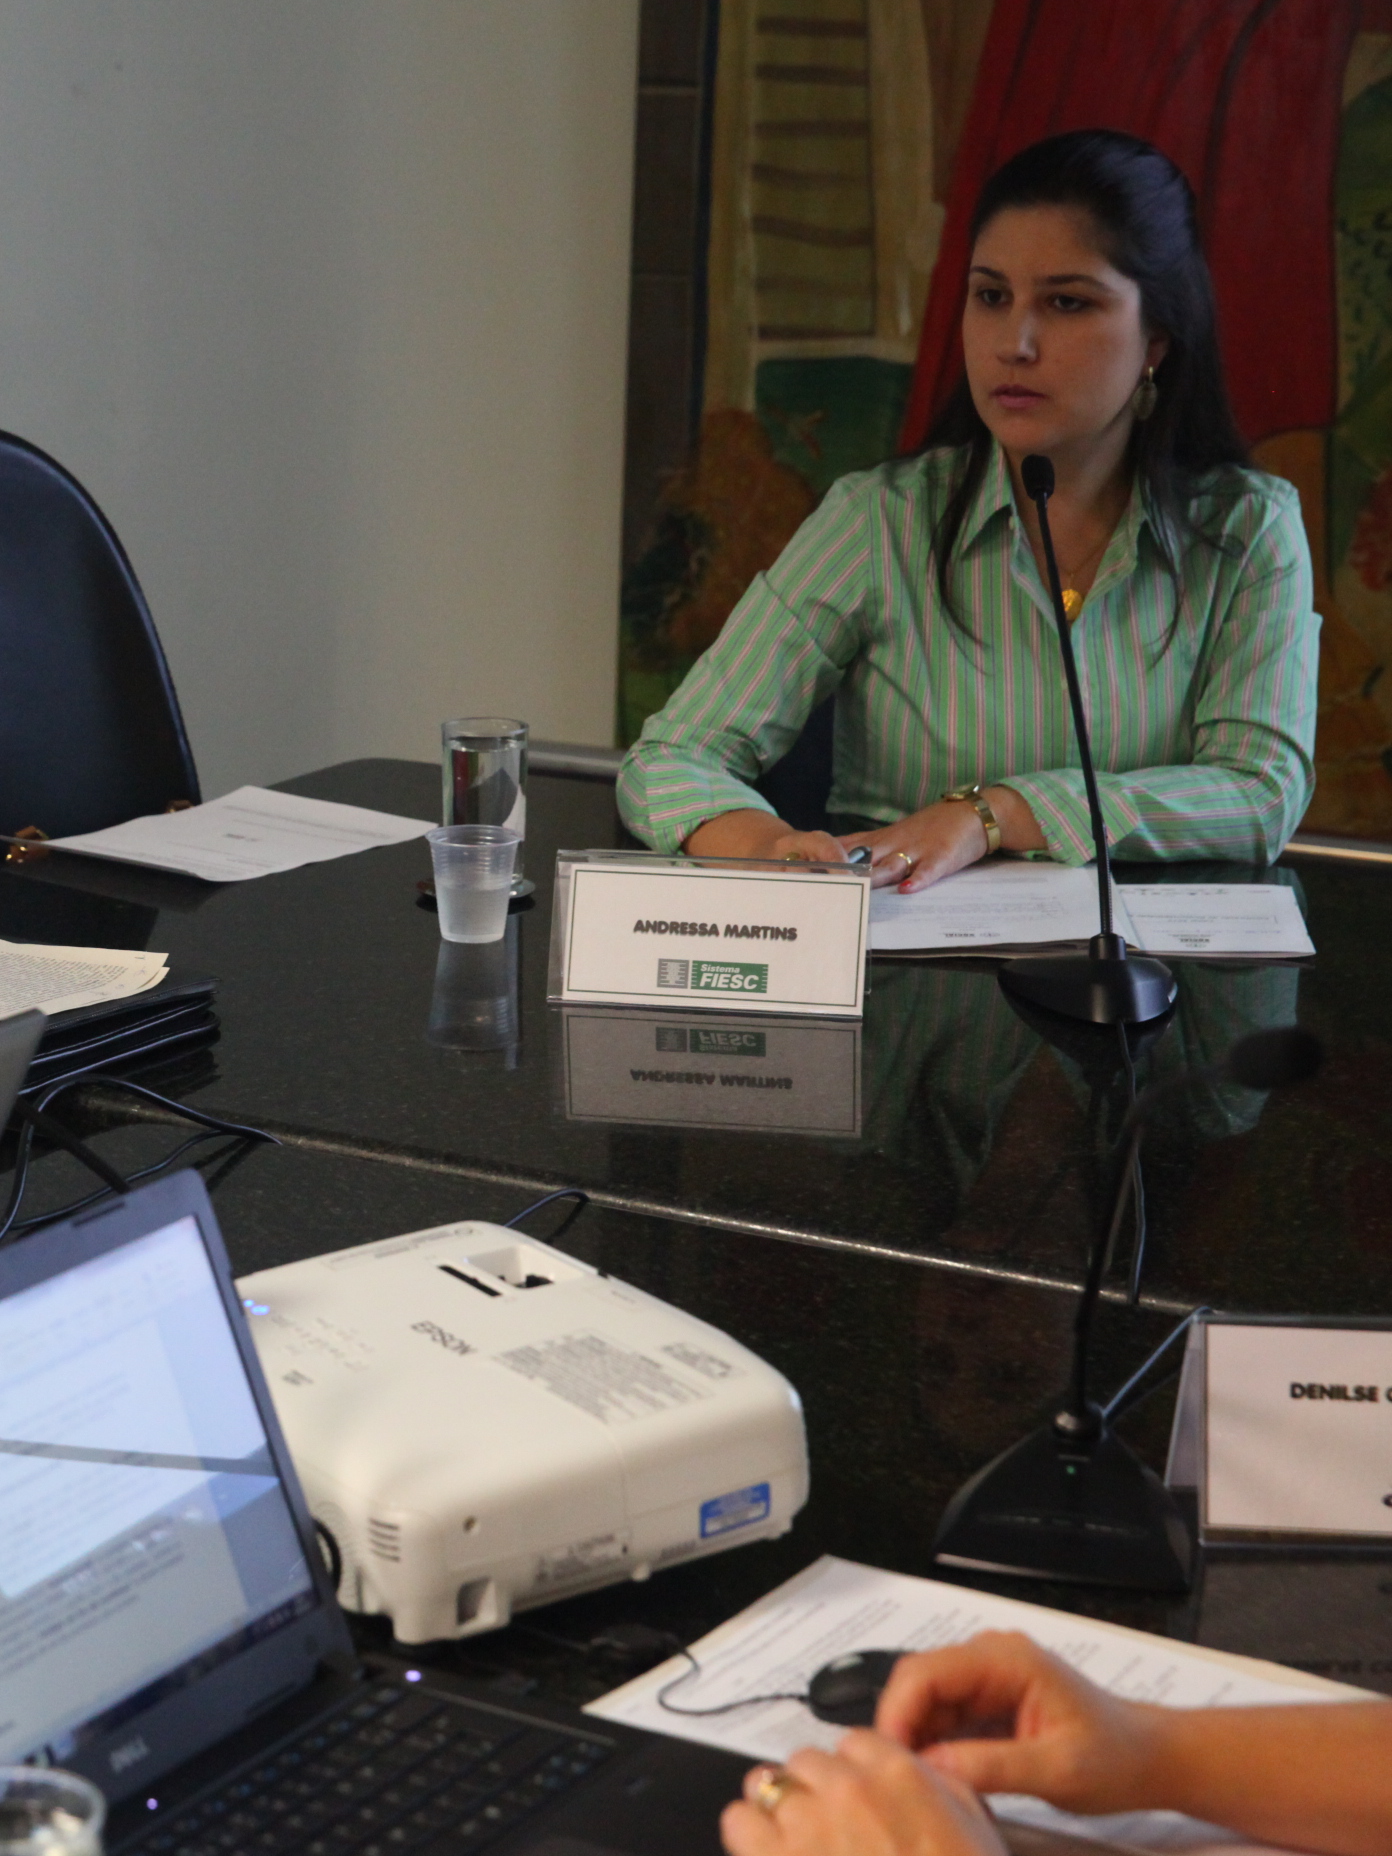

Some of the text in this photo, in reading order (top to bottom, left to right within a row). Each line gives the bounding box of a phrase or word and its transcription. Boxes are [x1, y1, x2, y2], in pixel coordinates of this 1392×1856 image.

[633, 919, 798, 941] ANDRESSA MARTINS
[700, 963, 740, 973] Sistema
[699, 973, 759, 990] FIESC
[410, 1320, 476, 1357] EPSON
[1290, 1382, 1379, 1403] DENILSE
